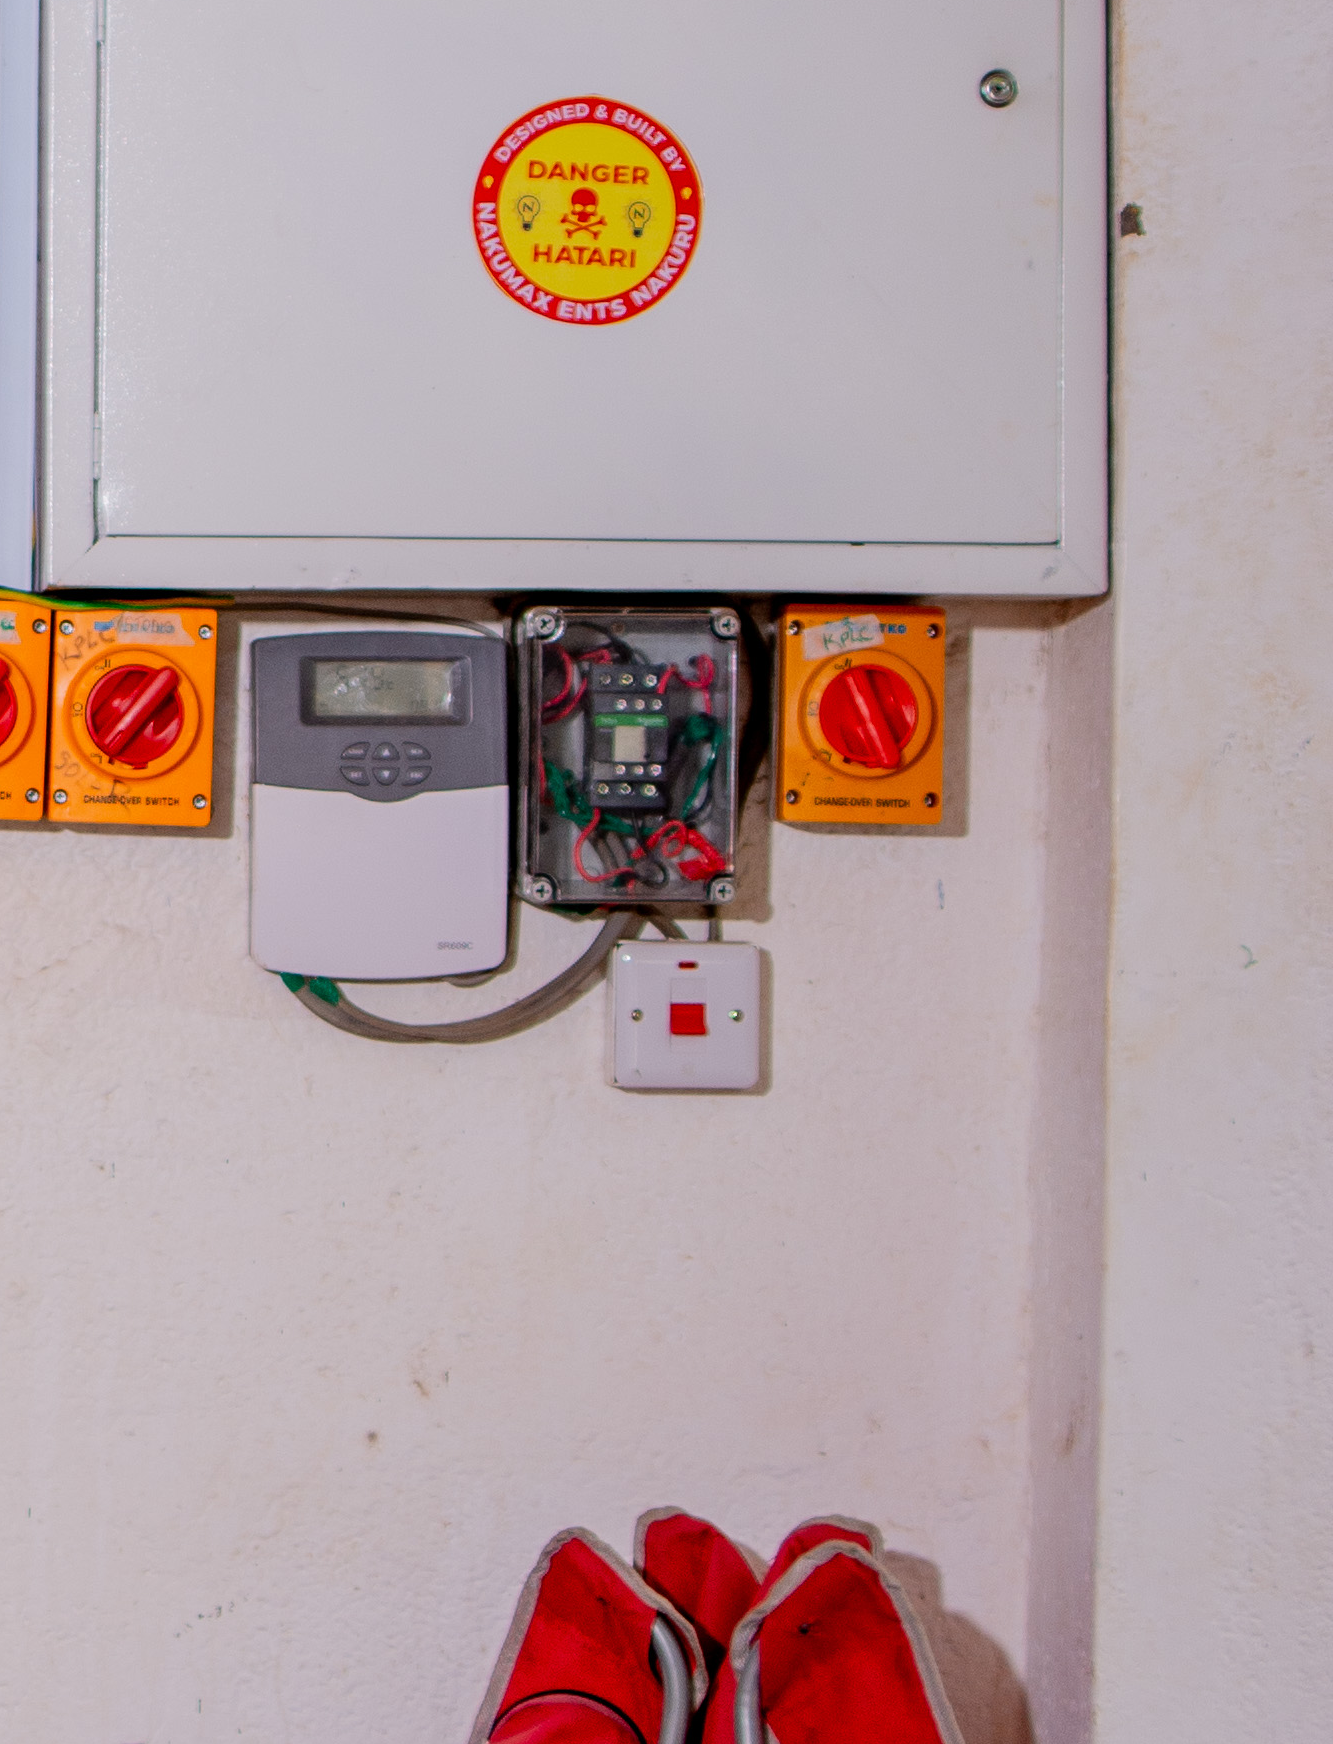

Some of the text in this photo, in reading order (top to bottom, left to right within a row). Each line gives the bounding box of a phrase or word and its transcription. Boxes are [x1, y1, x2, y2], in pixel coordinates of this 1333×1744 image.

[493, 103, 686, 171] DESIGNED & BUILT BY
[528, 159, 650, 185] DANGER
[476, 202, 696, 320] NAKUMAX ENTS NAKURU
[533, 243, 637, 268] HATARI
[145, 797, 180, 806] SWITCH
[814, 797, 910, 808] CHANGE-OVER SWITCH
